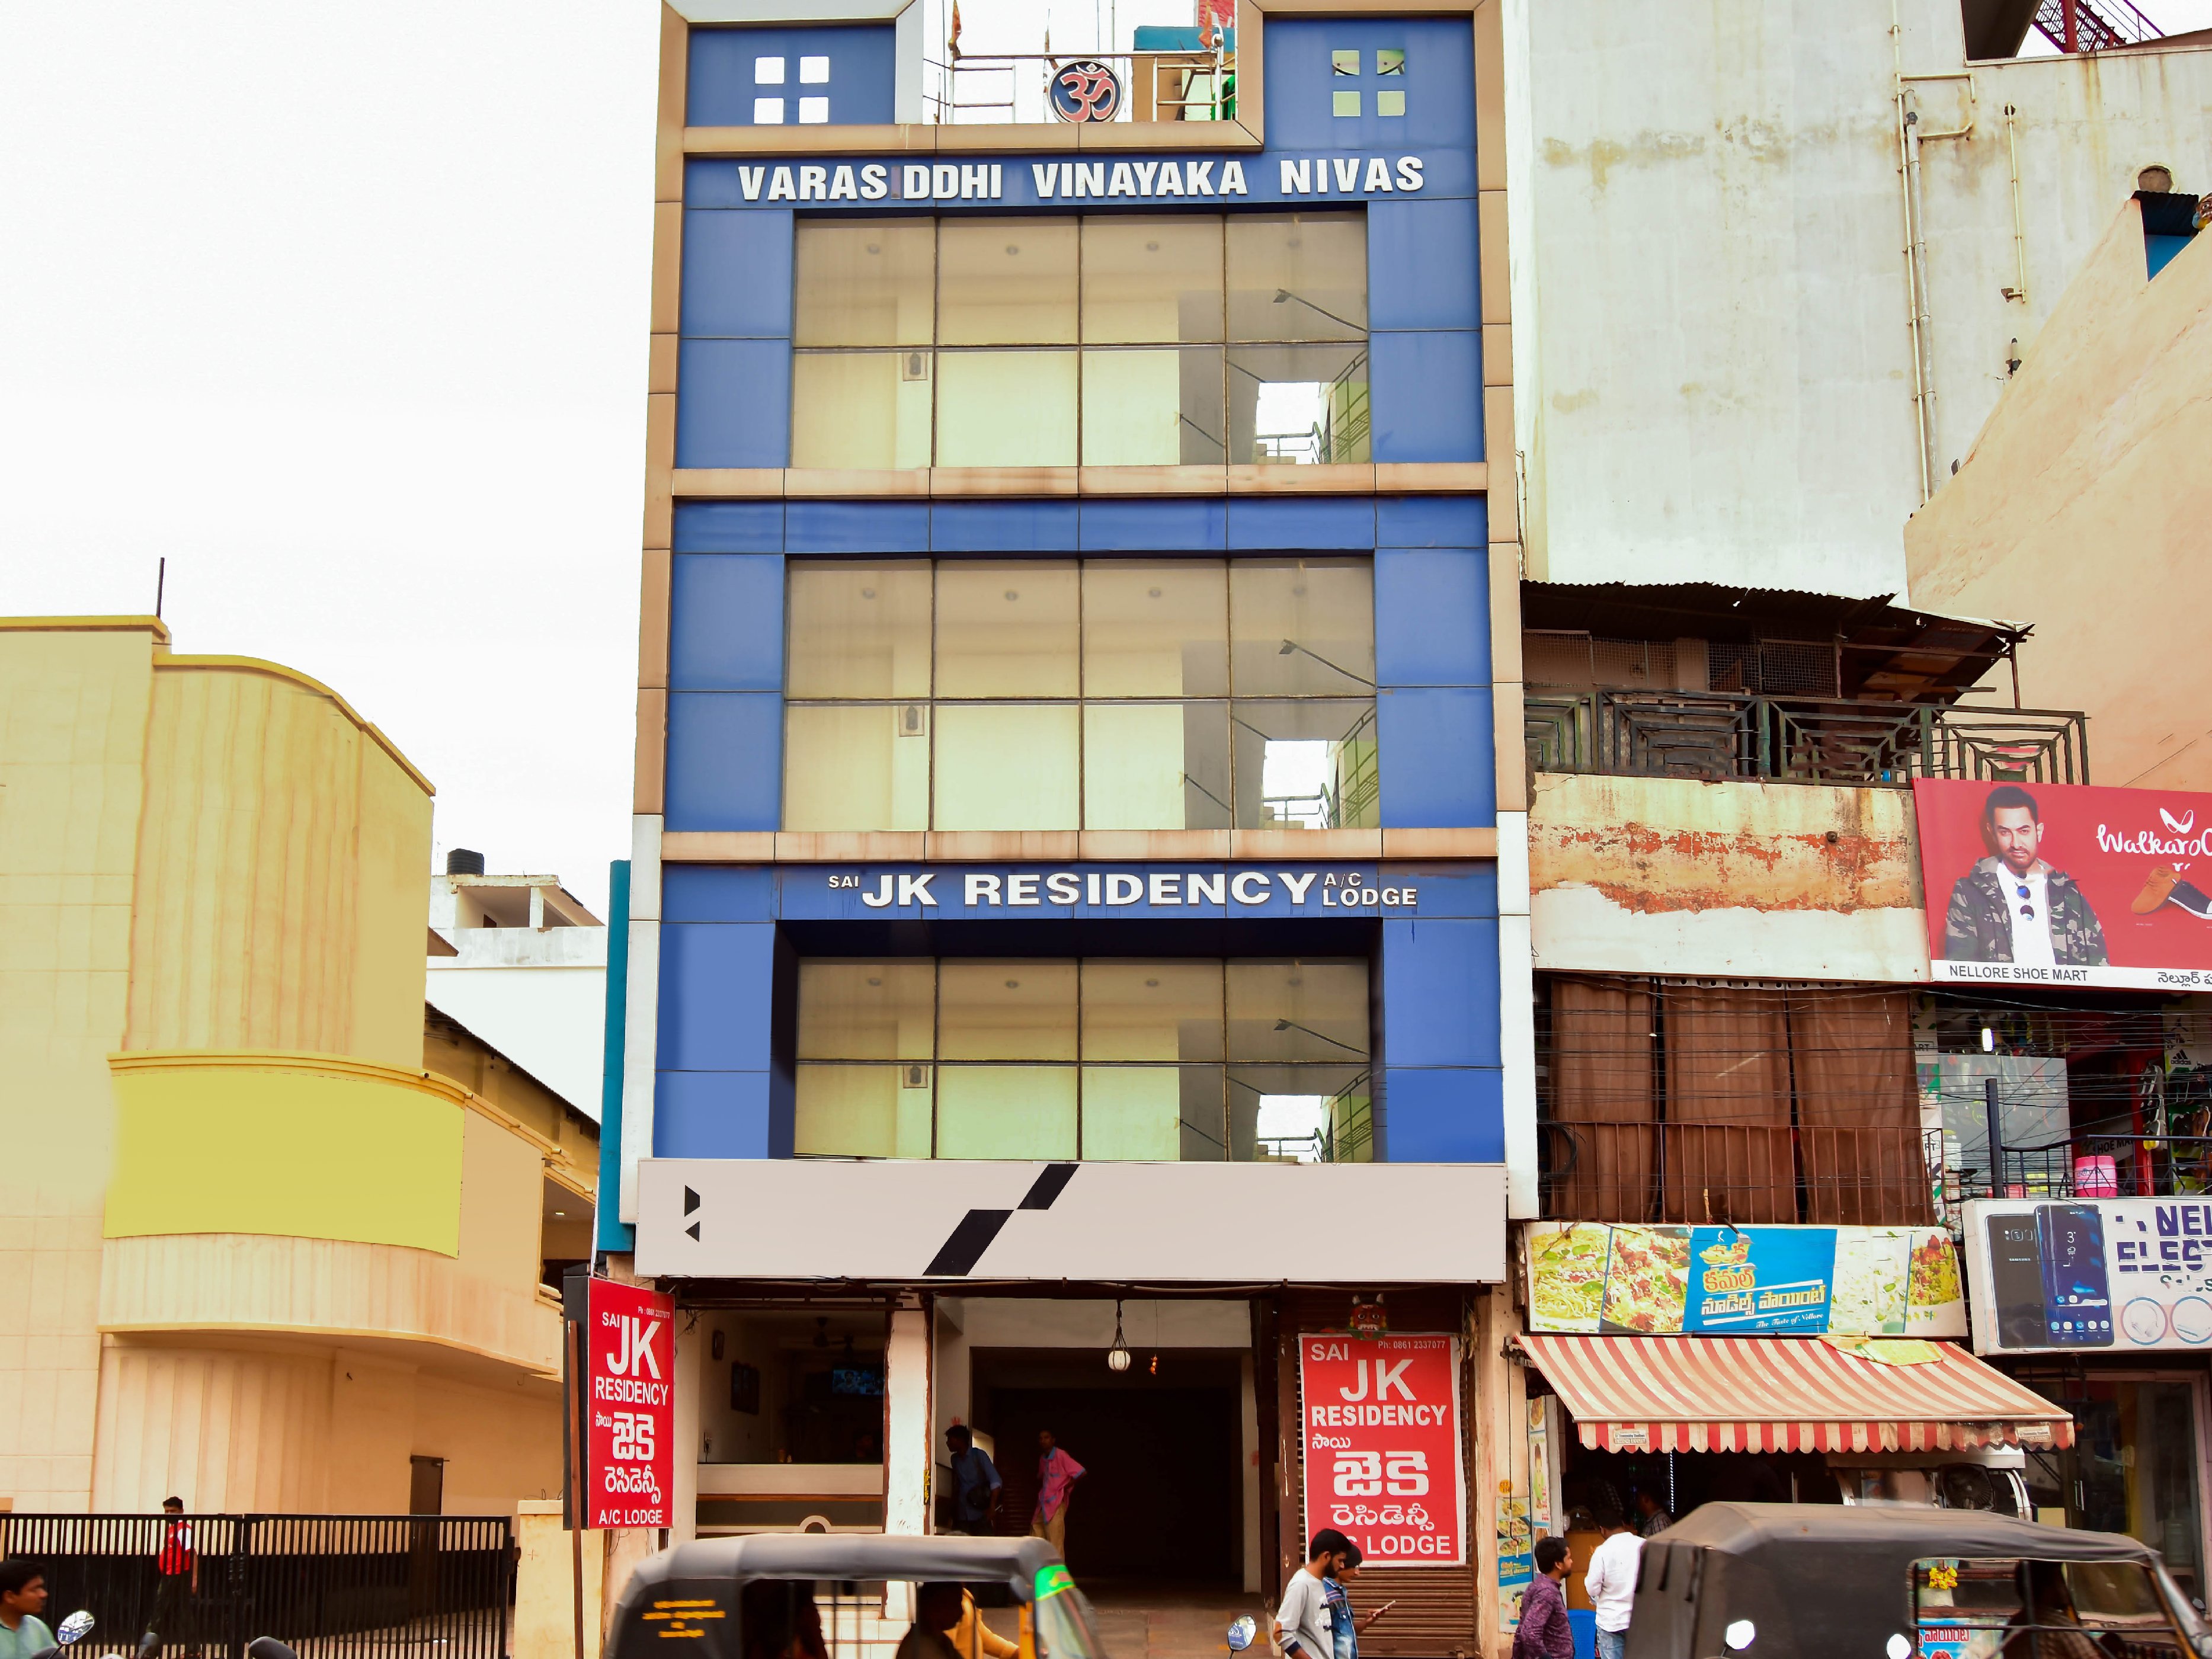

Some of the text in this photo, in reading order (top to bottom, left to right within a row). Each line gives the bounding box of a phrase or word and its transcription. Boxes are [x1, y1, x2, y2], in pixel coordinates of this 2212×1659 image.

[1032, 161, 1248, 197] VINAYAKA
[1280, 155, 1424, 196] NIVAS
[828, 871, 1362, 907] SAI JK RESIDENCY A/C
[1323, 888, 1418, 907] LODGE
[1949, 965, 2088, 981] NELLORE SHOE MART
[602, 1312, 620, 1327] SAI
[606, 1315, 661, 1379] JK
[1311, 1343, 1349, 1361] SAI
[1393, 1341, 1411, 1349] 0861
[1414, 1341, 1446, 1349] 2337077
[1339, 1359, 1417, 1402] JK
[596, 1376, 668, 1406] RESIDENCY
[1311, 1404, 1447, 1427] RESIDENCY
[598, 1509, 662, 1525] A/C LODGE
[1367, 1536, 1451, 1554] LODGE
